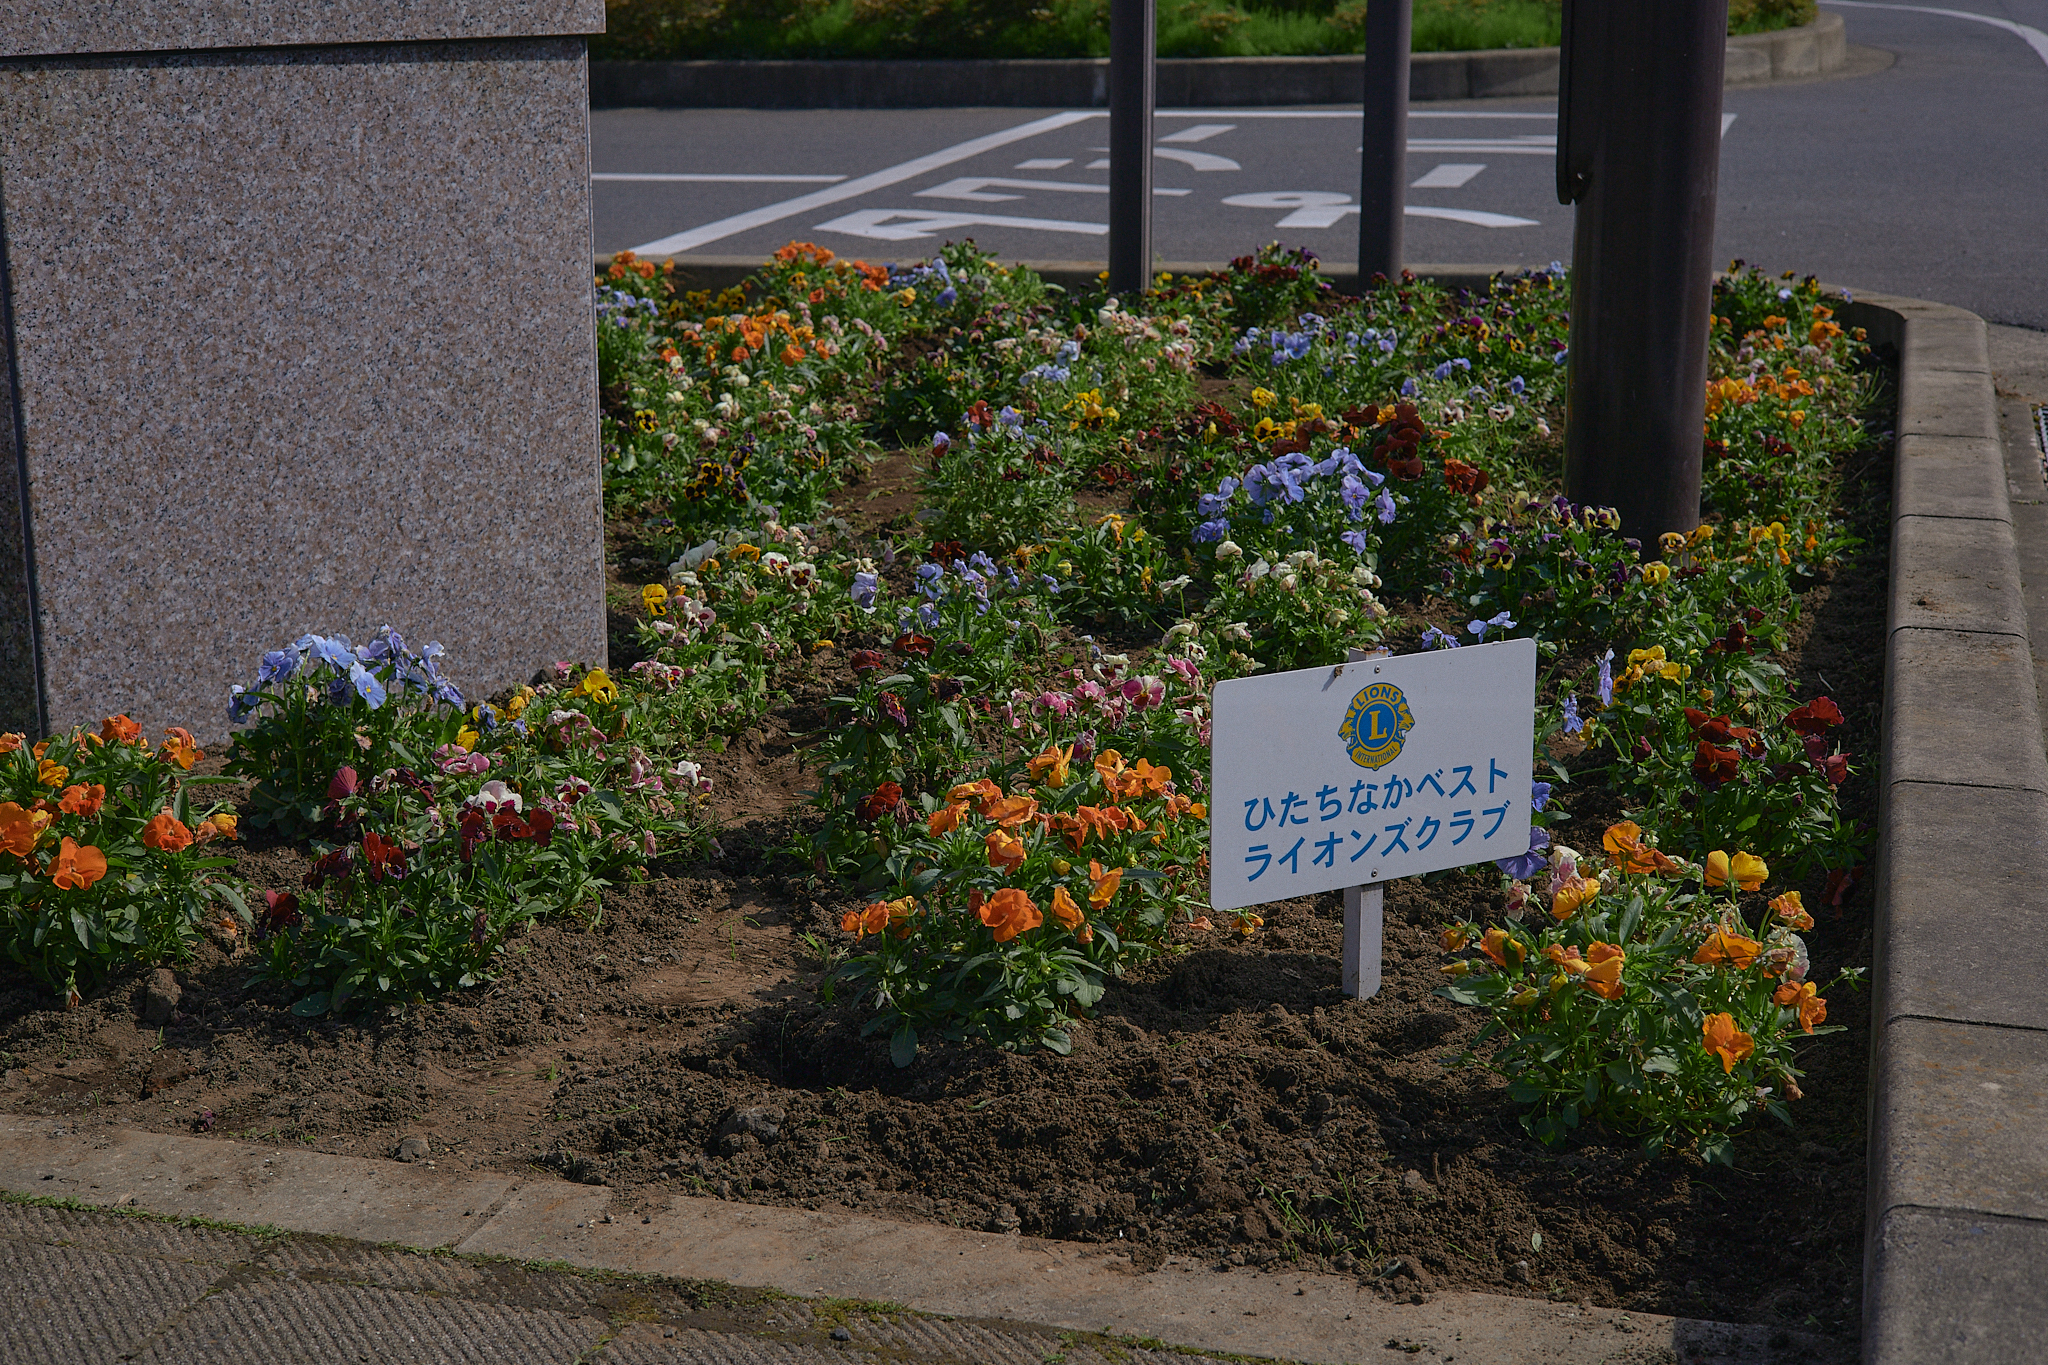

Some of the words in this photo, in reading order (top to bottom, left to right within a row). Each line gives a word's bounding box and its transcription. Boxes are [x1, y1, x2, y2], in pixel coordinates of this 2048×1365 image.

[812, 124, 1241, 241] タクシー
[1355, 686, 1399, 707] LIONS
[1369, 710, 1387, 740] L
[1355, 746, 1398, 763] INTERNATIONAL
[1244, 758, 1508, 831] ひたちなかベスト
[1244, 800, 1511, 882] ライオンズクラブ
